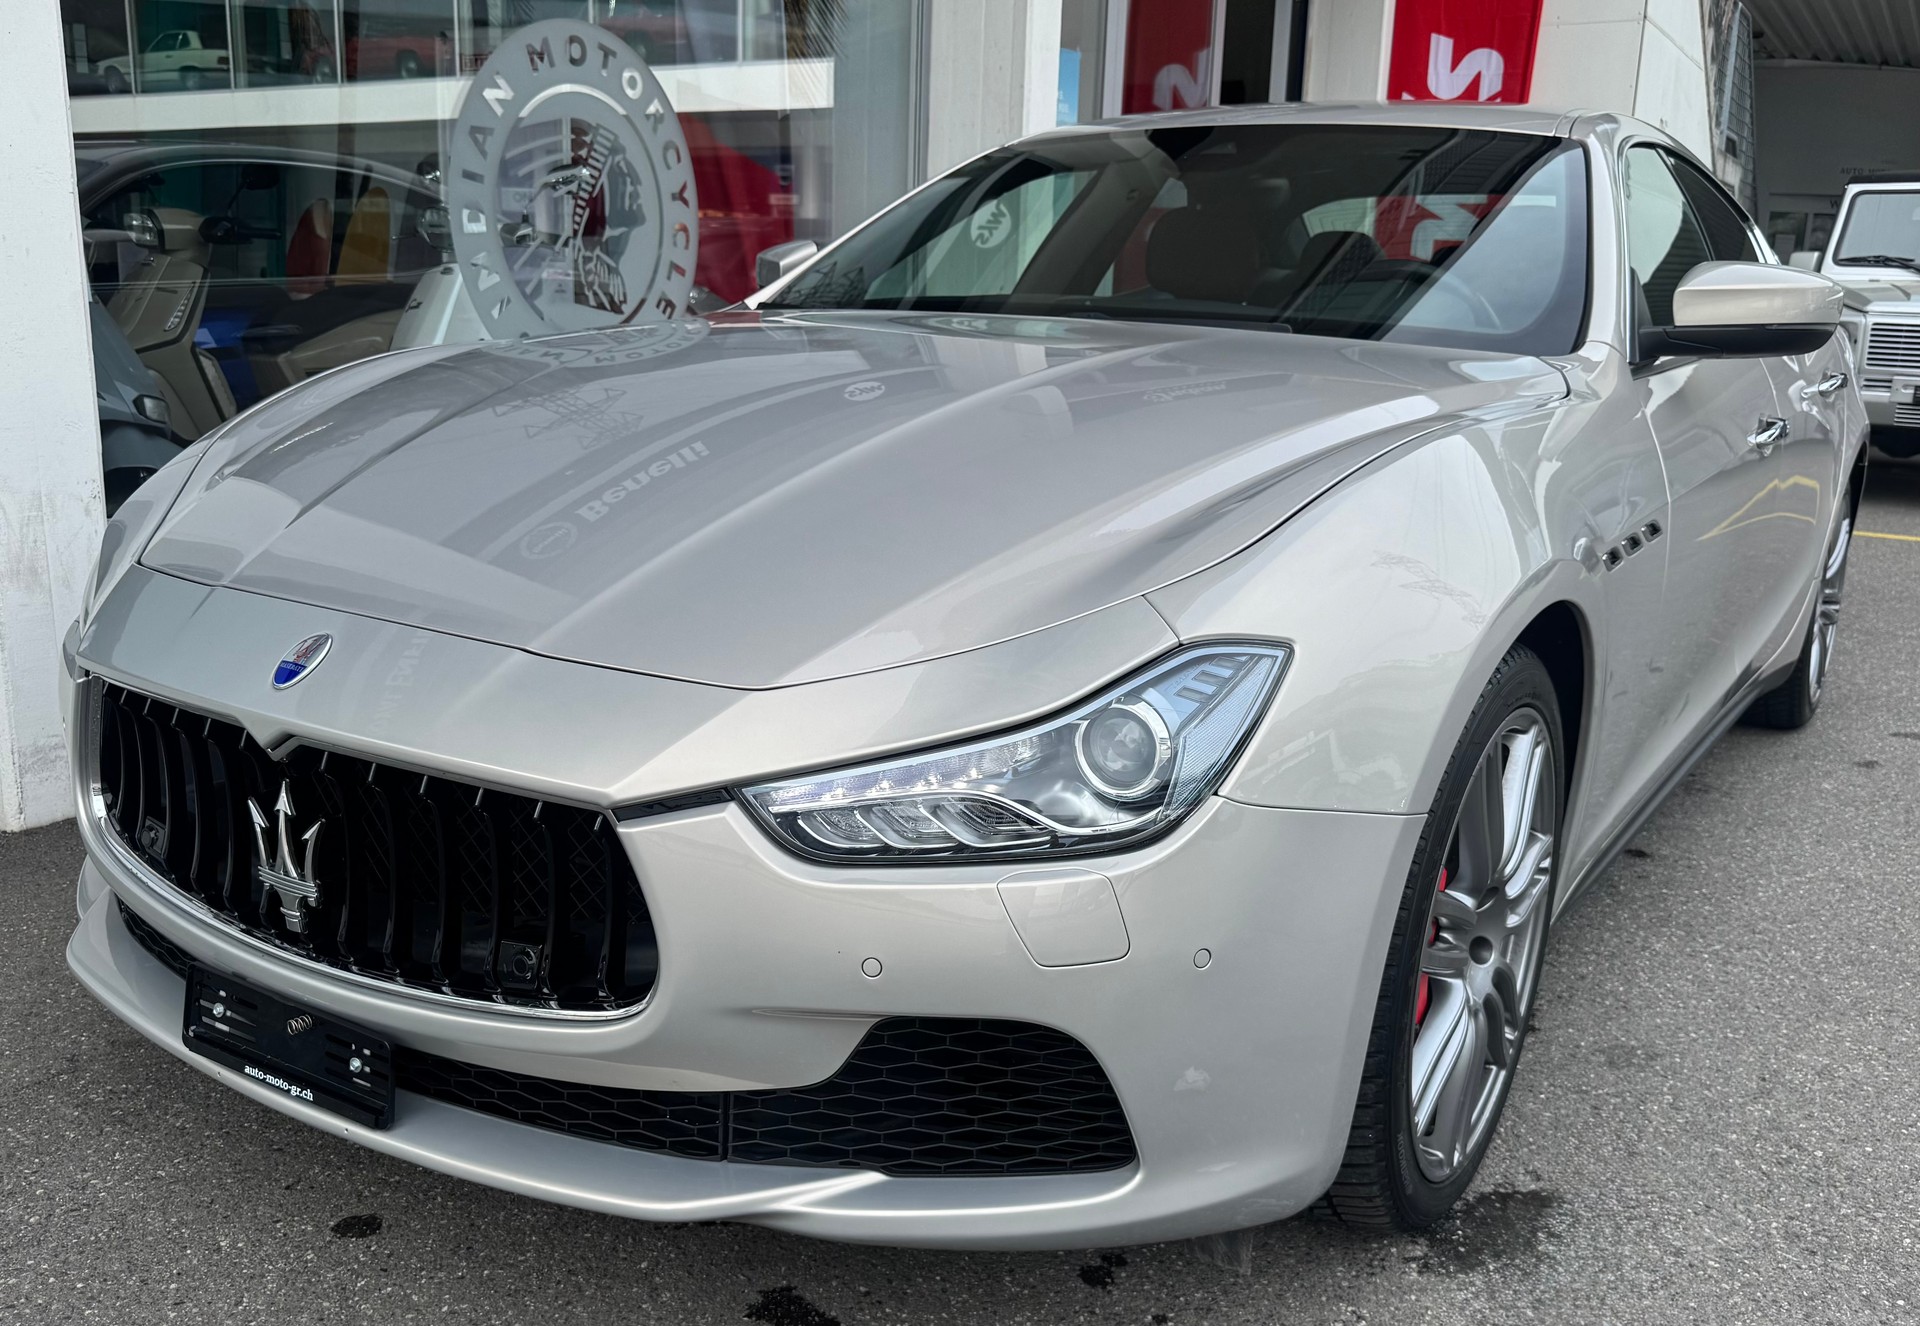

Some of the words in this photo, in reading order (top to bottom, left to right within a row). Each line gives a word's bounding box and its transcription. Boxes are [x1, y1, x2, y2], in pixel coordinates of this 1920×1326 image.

[461, 70, 515, 320] INDIAN
[525, 34, 691, 320] MOTORCYCLE
[278, 661, 306, 674] MASERATI
[244, 1065, 314, 1102] auto-moto-gr.ch
